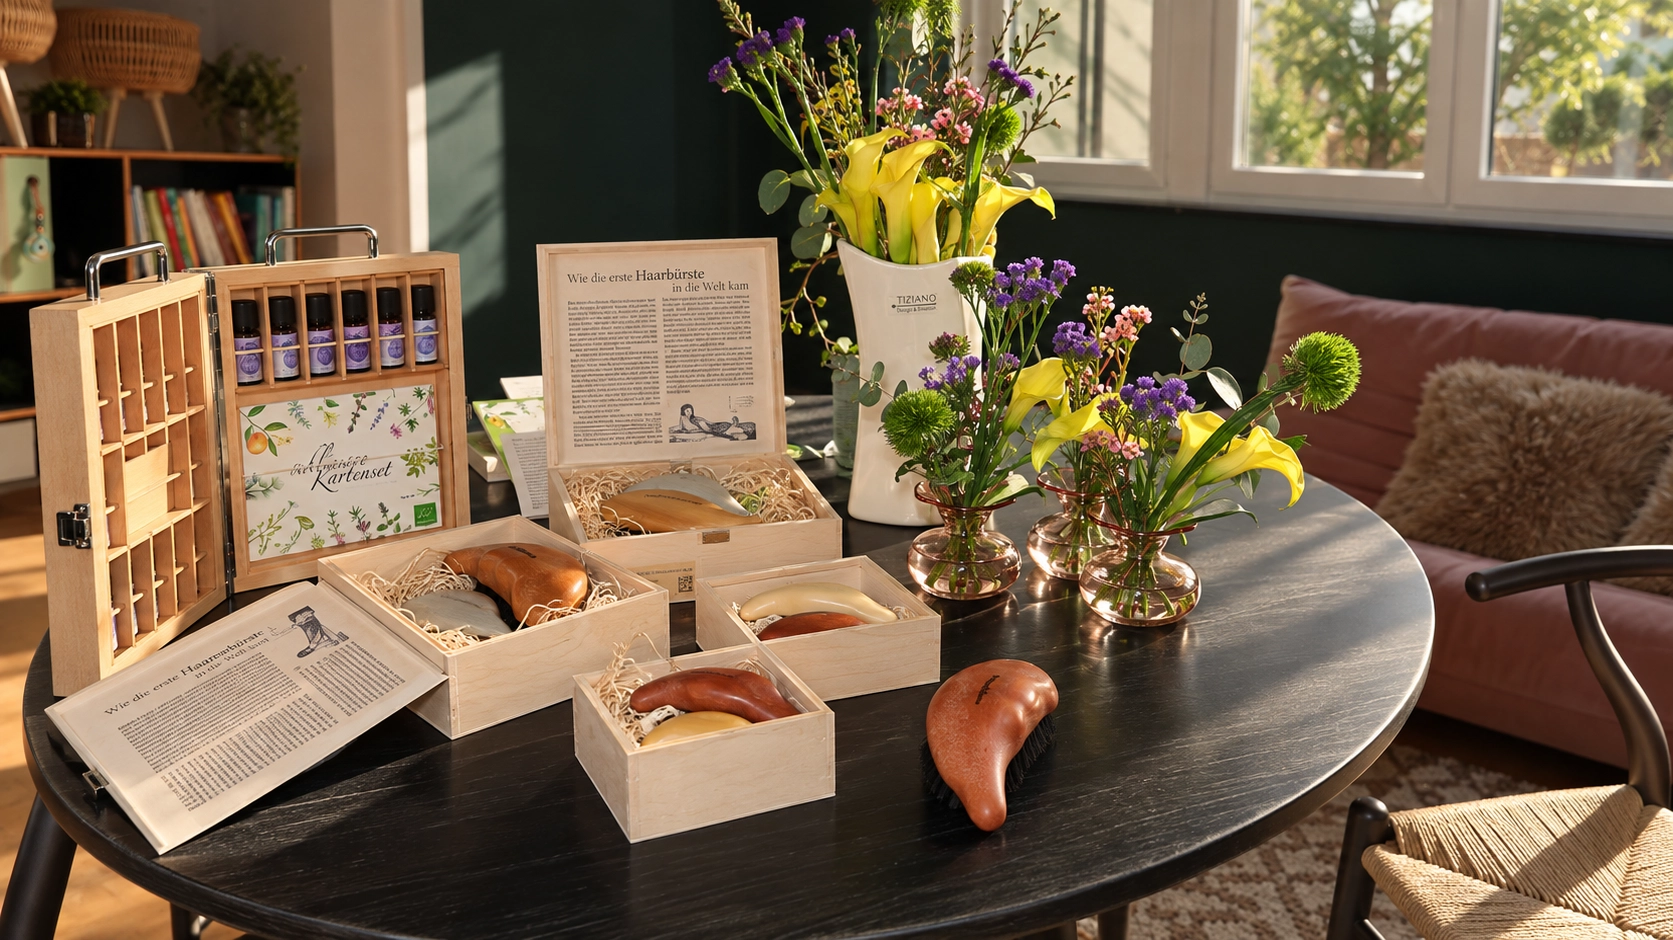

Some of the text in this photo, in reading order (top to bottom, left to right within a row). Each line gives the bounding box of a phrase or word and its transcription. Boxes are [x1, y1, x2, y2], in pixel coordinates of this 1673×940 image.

[567, 268, 705, 283] Wie die erste Haarbürste
[672, 280, 749, 293] in die Welt kam
[896, 294, 937, 304] TIZIANO
[311, 461, 393, 493] Kartenset
[104, 701, 130, 715] Wie
[132, 689, 151, 702] die
[153, 674, 180, 691] erste
